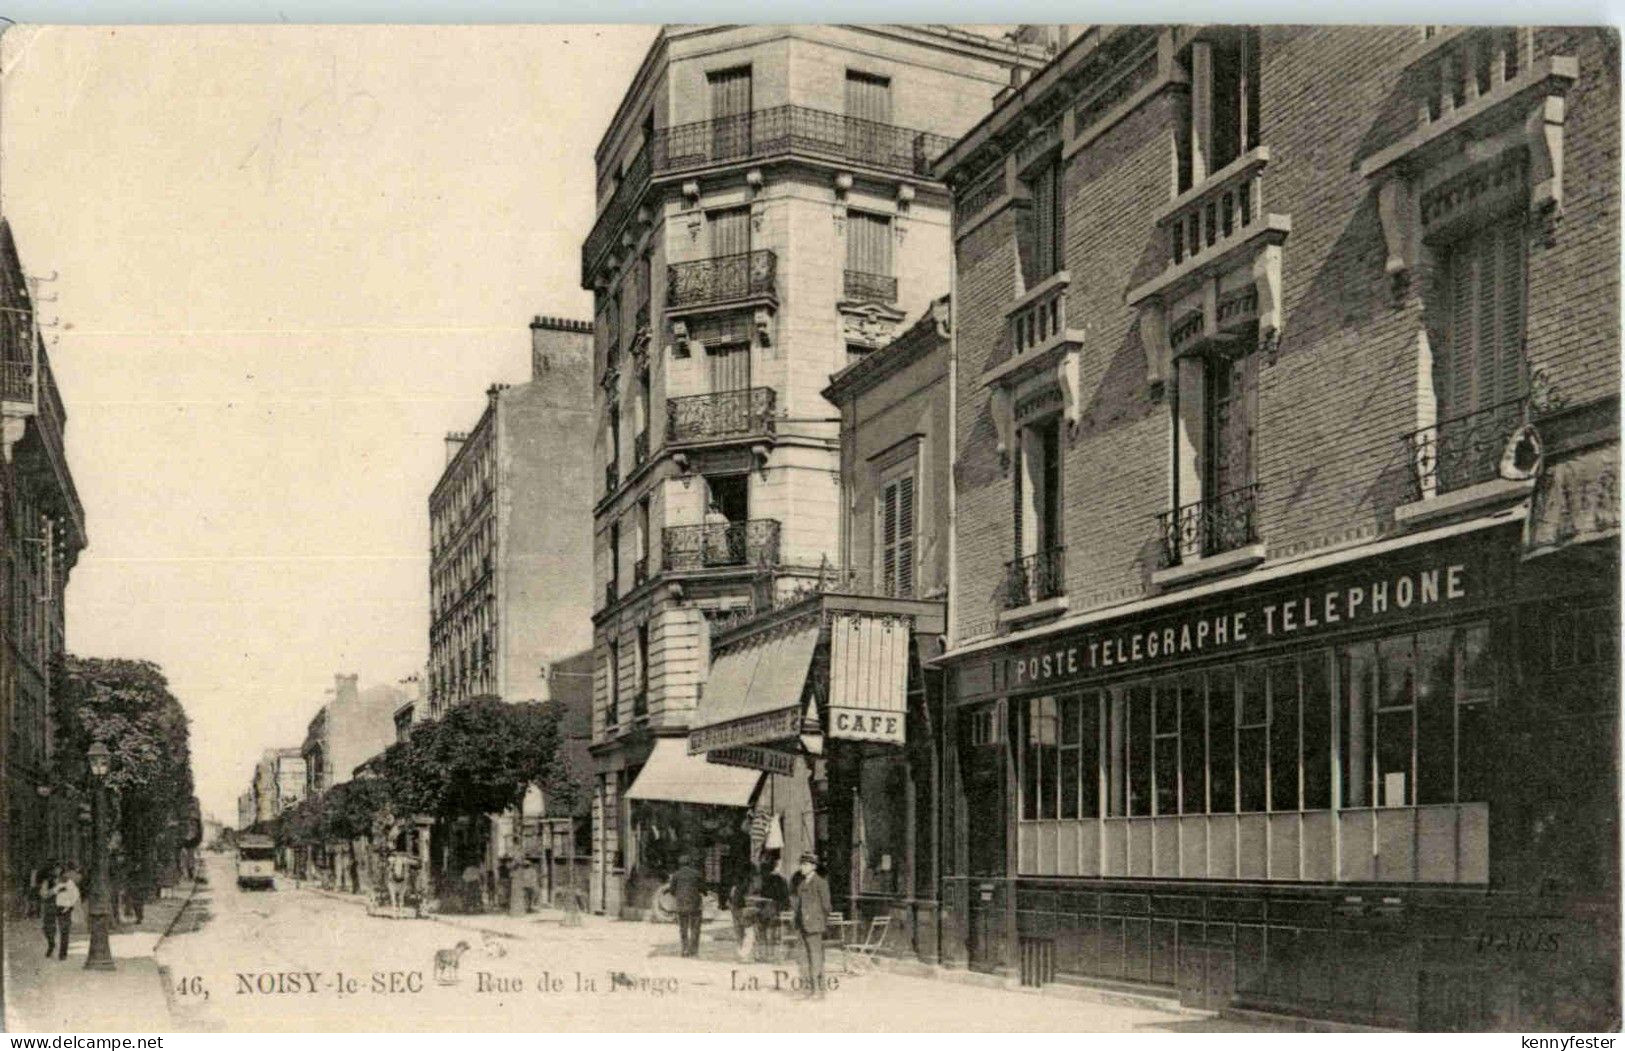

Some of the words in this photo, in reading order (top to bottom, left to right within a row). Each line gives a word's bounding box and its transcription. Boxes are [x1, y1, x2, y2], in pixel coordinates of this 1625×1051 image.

[1017, 648, 1079, 682] POSTE
[1089, 612, 1248, 667] TELEGRAPHE
[1263, 565, 1467, 635] TELEPHONE
[837, 713, 897, 733] CAFE
